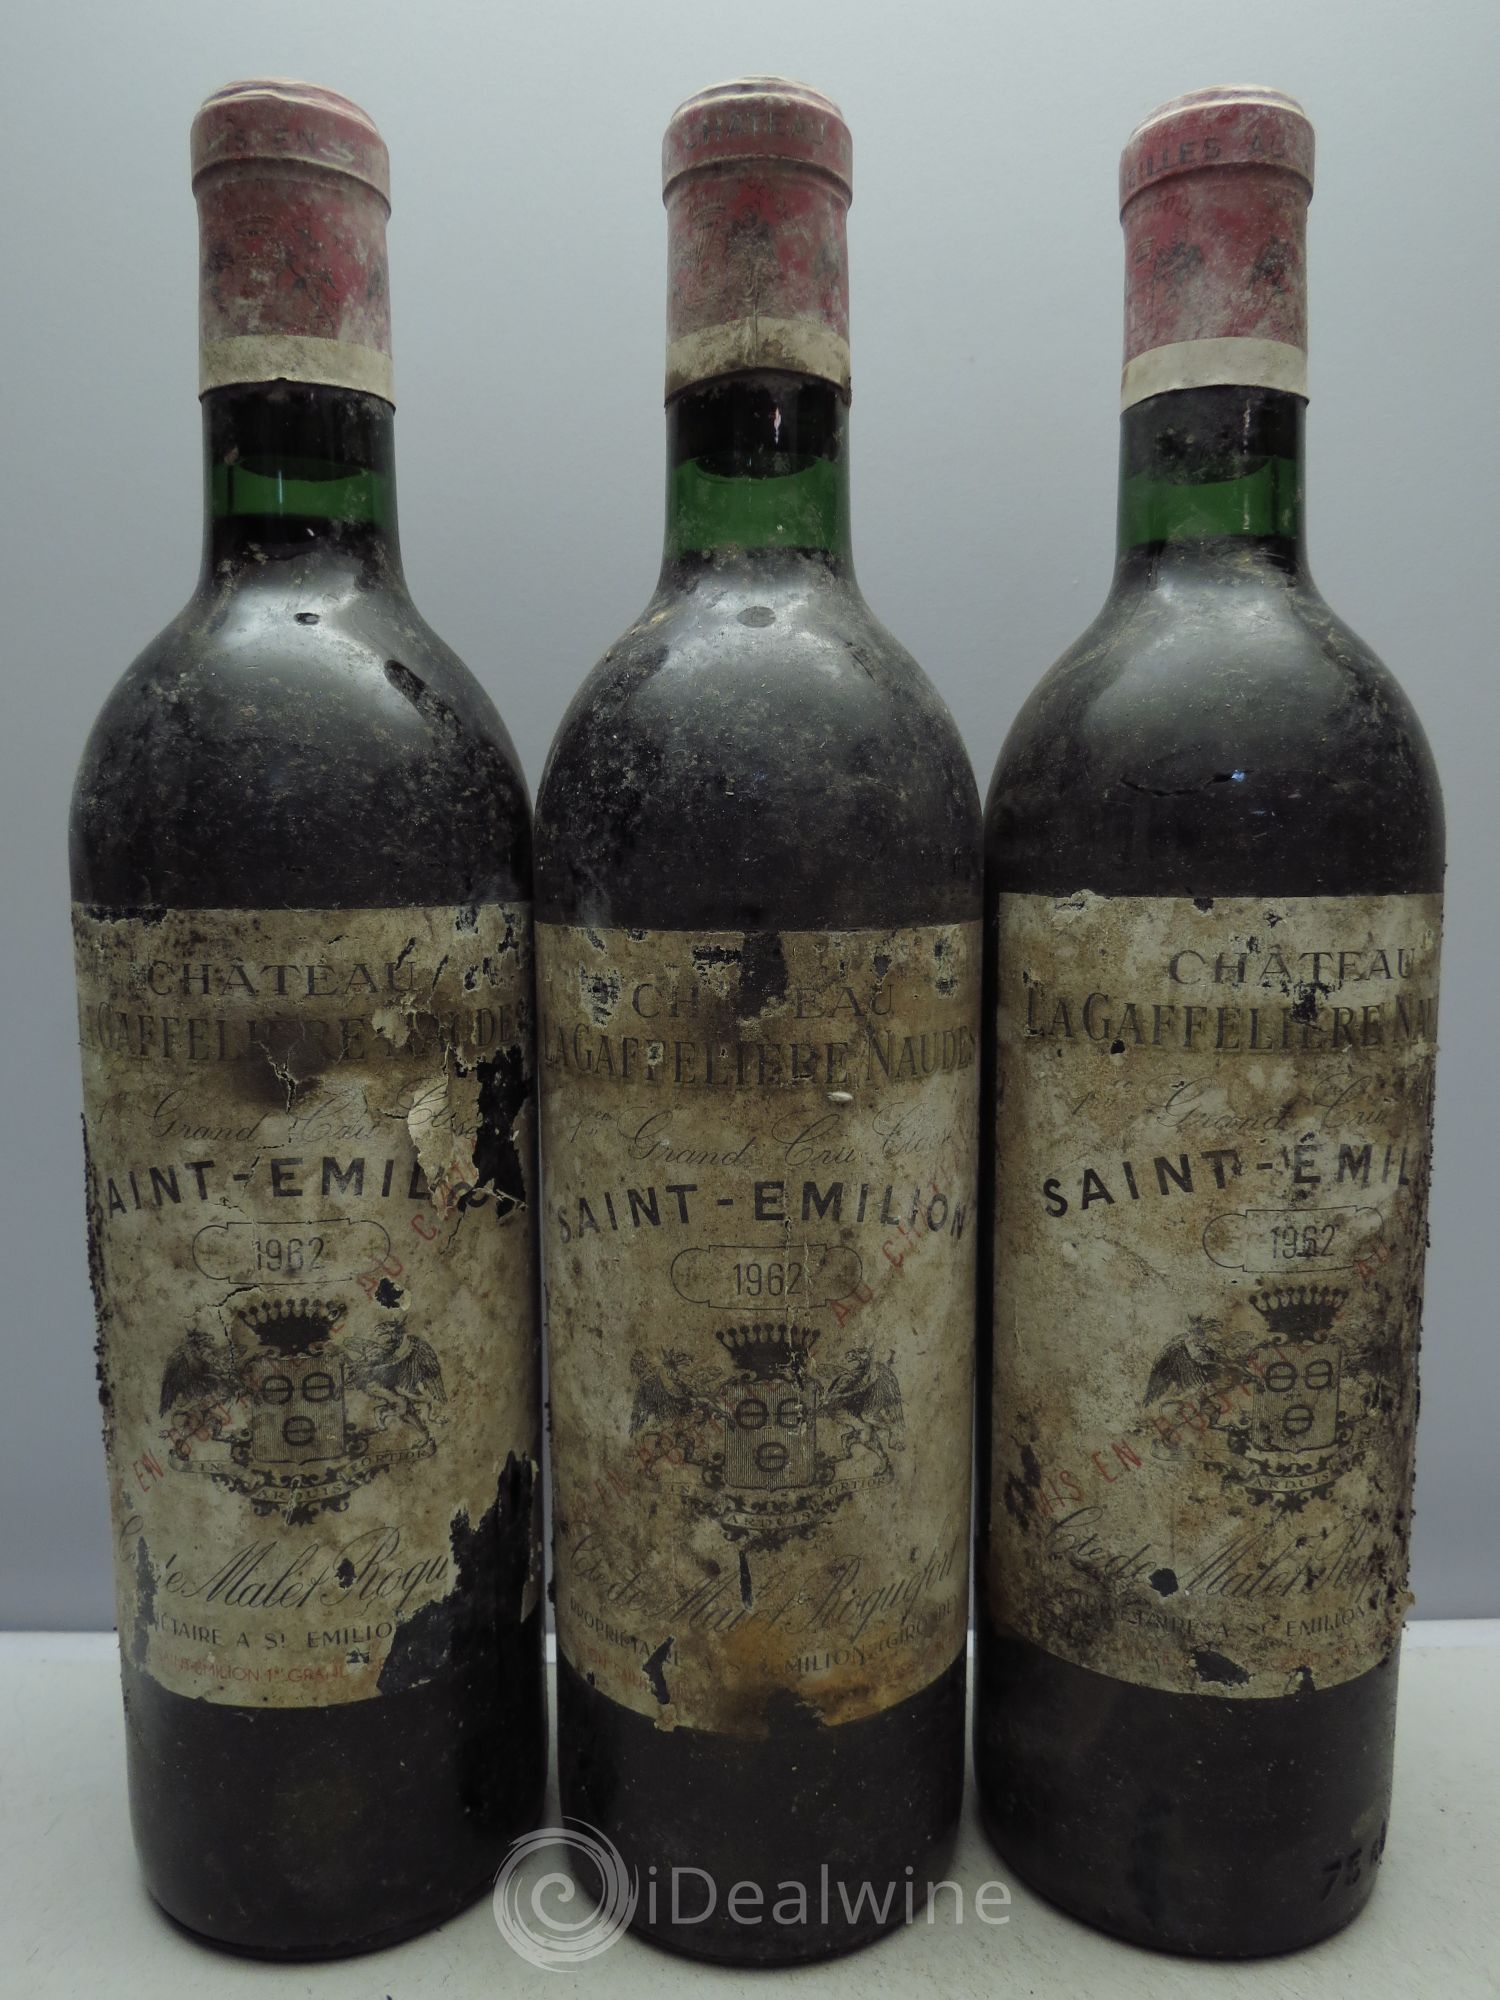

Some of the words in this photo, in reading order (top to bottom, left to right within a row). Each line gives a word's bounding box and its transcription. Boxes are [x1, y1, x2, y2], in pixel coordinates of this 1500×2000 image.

[616, 1106, 757, 1167] Grand
[771, 1109, 856, 1167] Cru
[254, 1236, 324, 1272] 1962
[1271, 1224, 1335, 1259] 1962
[732, 1262, 802, 1297] 1962
[307, 1621, 393, 1649] EMILIO
